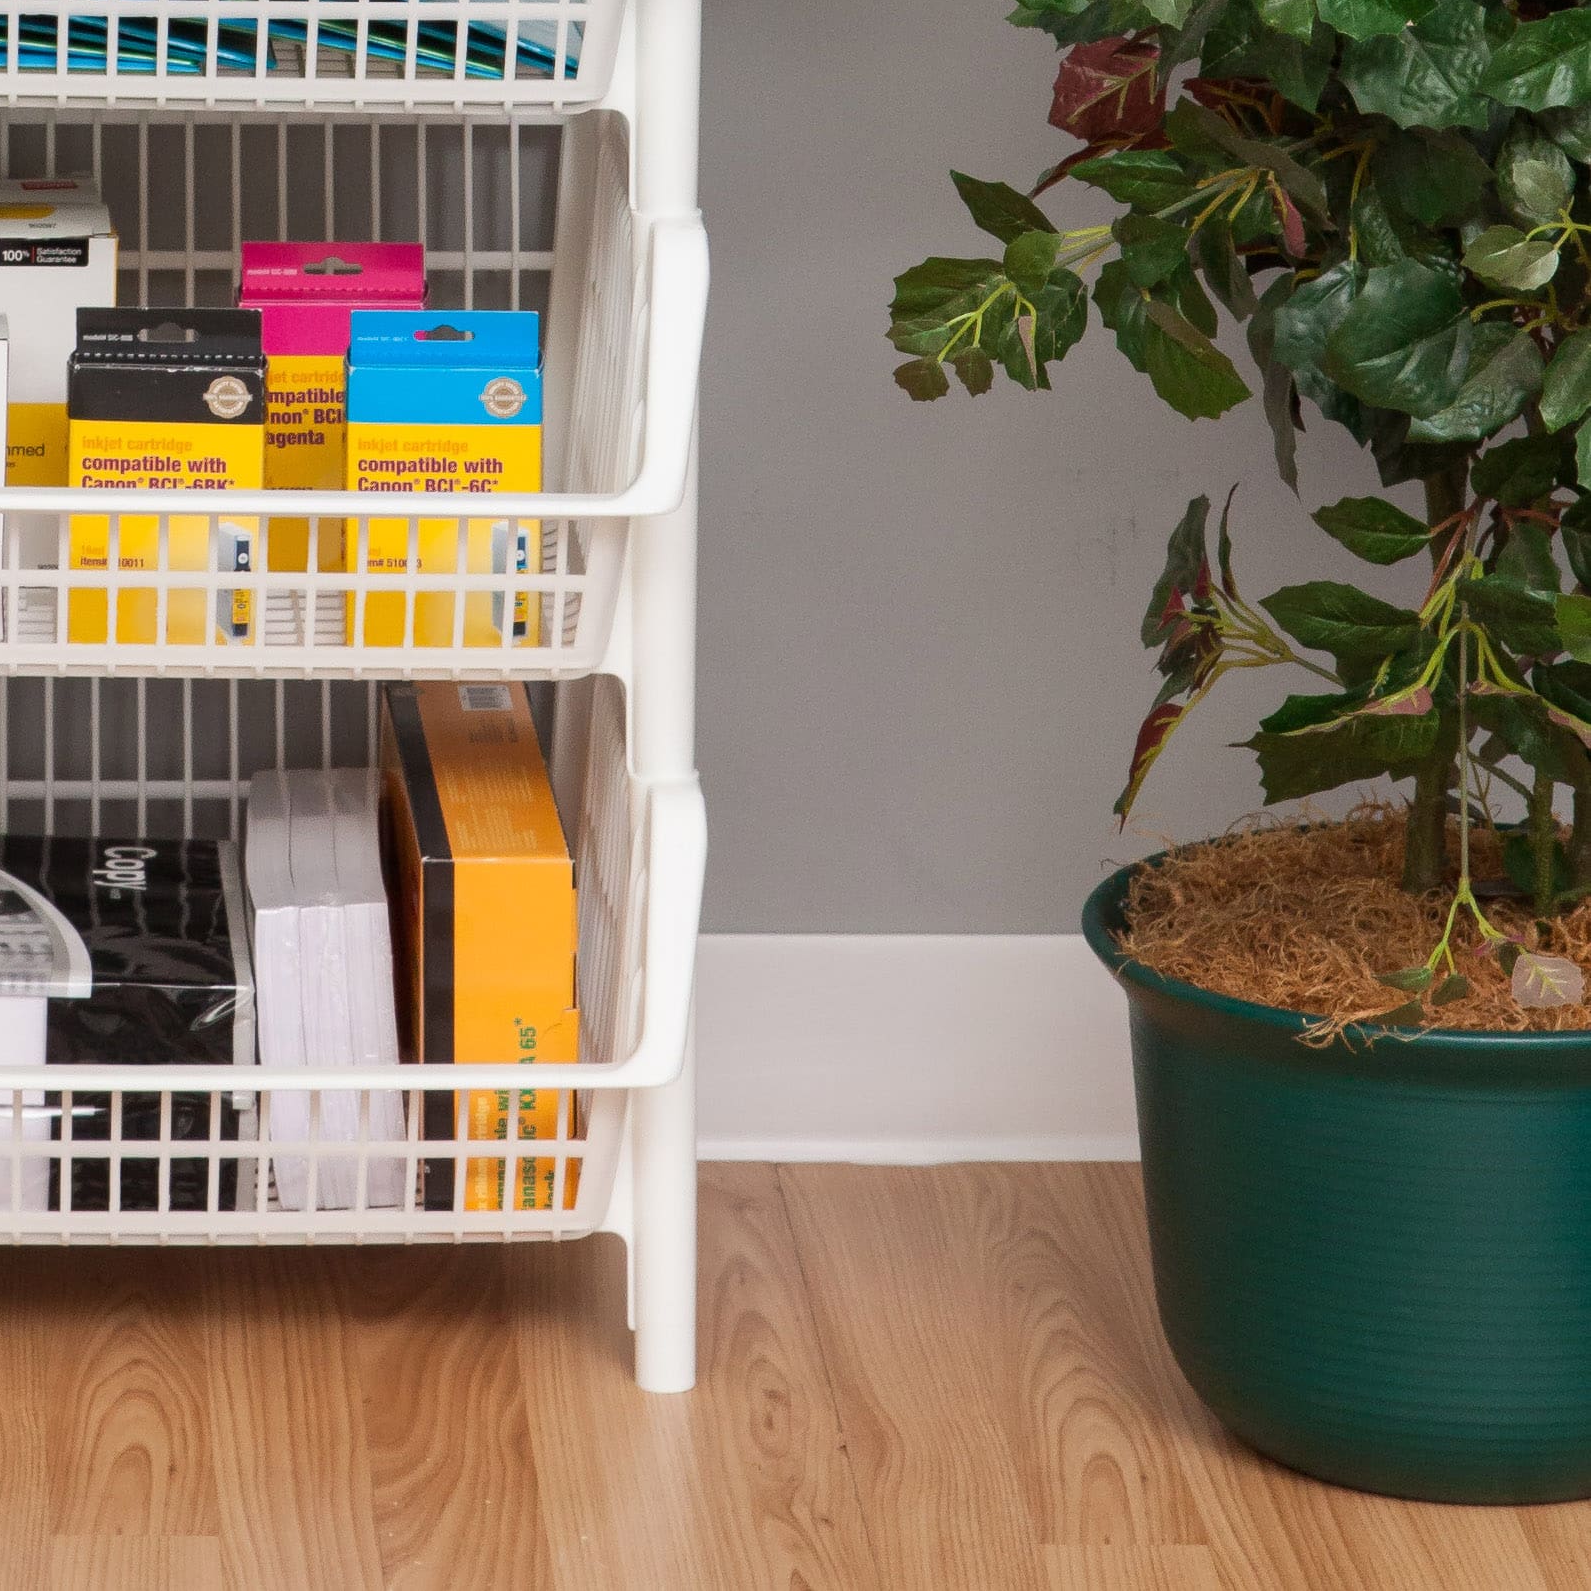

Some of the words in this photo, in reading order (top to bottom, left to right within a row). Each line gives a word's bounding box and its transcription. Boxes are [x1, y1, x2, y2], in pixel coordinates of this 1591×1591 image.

[36, 247, 82, 257] Satisfaction
[267, 388, 343, 407] mpatible
[82, 436, 122, 452] inkjet
[127, 438, 192, 453] cartridge
[266, 430, 325, 448] agenta
[357, 438, 398, 454] inkjet
[403, 439, 468, 454] cartridge
[82, 456, 181, 475] compatible
[187, 457, 227, 473] with
[358, 457, 457, 475] compatible
[464, 458, 503, 474] with
[118, 557, 144, 568] 10011
[93, 845, 158, 891] Copy
